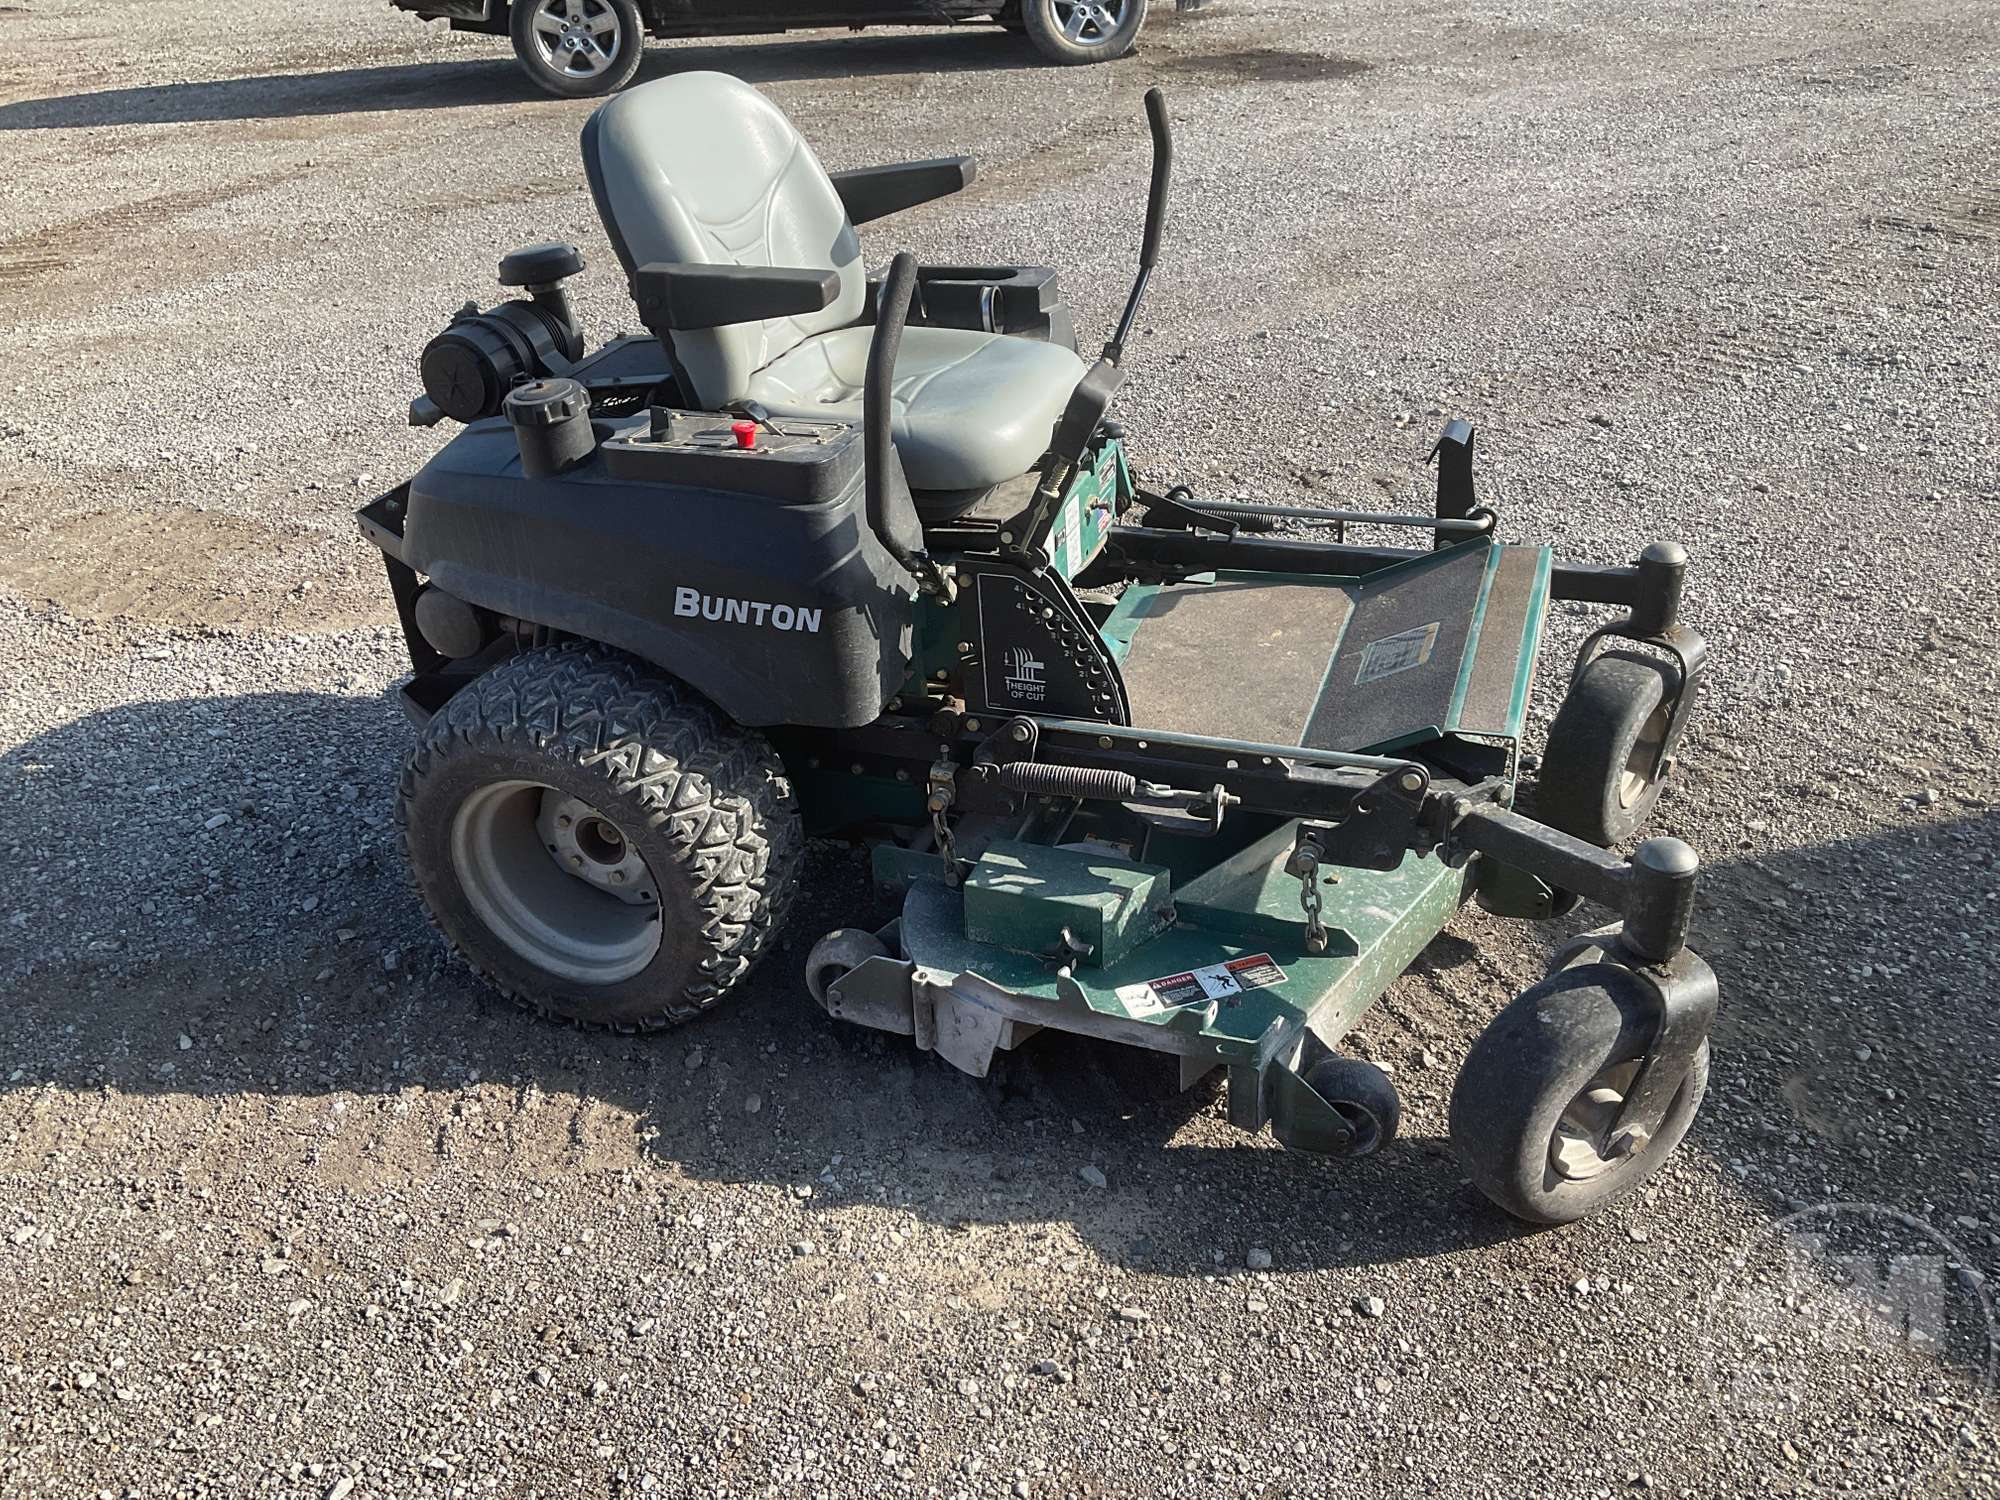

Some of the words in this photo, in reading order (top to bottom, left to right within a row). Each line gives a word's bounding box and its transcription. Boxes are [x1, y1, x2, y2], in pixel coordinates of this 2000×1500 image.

[673, 586, 822, 633] BUNTON
[1010, 682, 1046, 693] HEIGHT
[1010, 690, 1025, 699] OF
[1026, 692, 1047, 701] CUT
